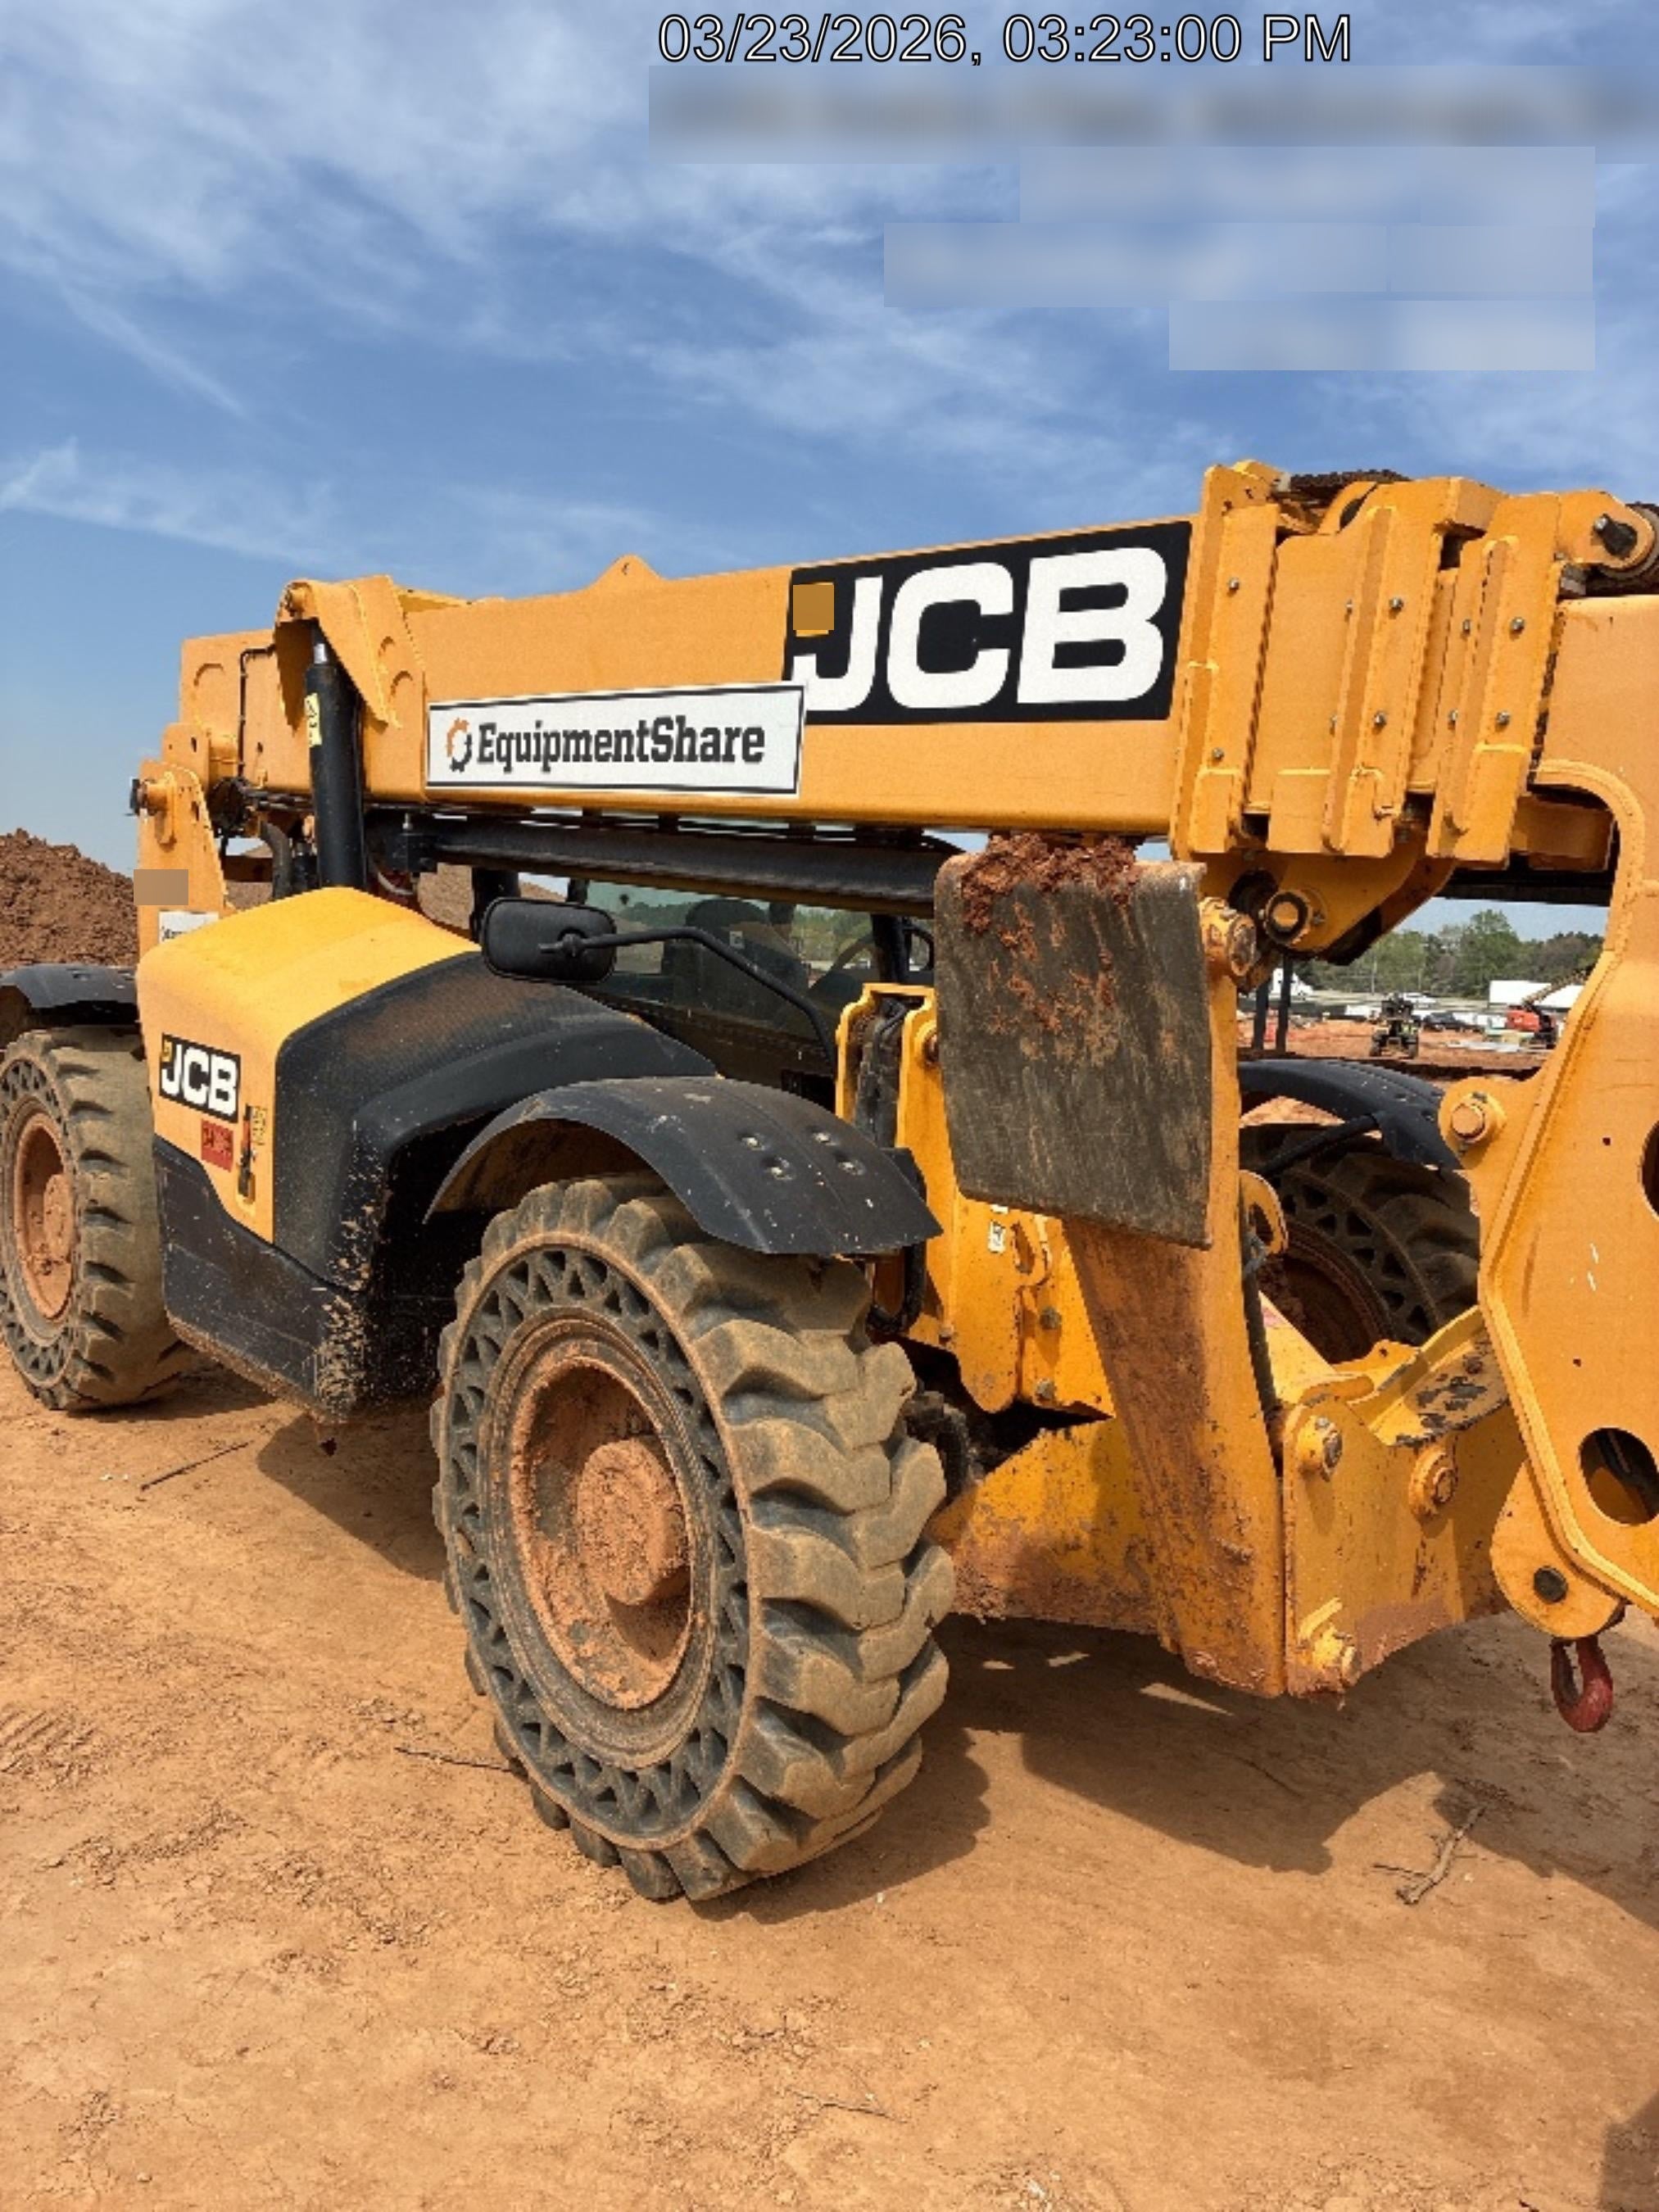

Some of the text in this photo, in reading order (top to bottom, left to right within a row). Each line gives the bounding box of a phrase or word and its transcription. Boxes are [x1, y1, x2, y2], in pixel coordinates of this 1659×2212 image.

[791, 546, 1168, 712] JCB
[476, 714, 766, 773] EquipmentShare
[161, 1043, 238, 1117] JCB
